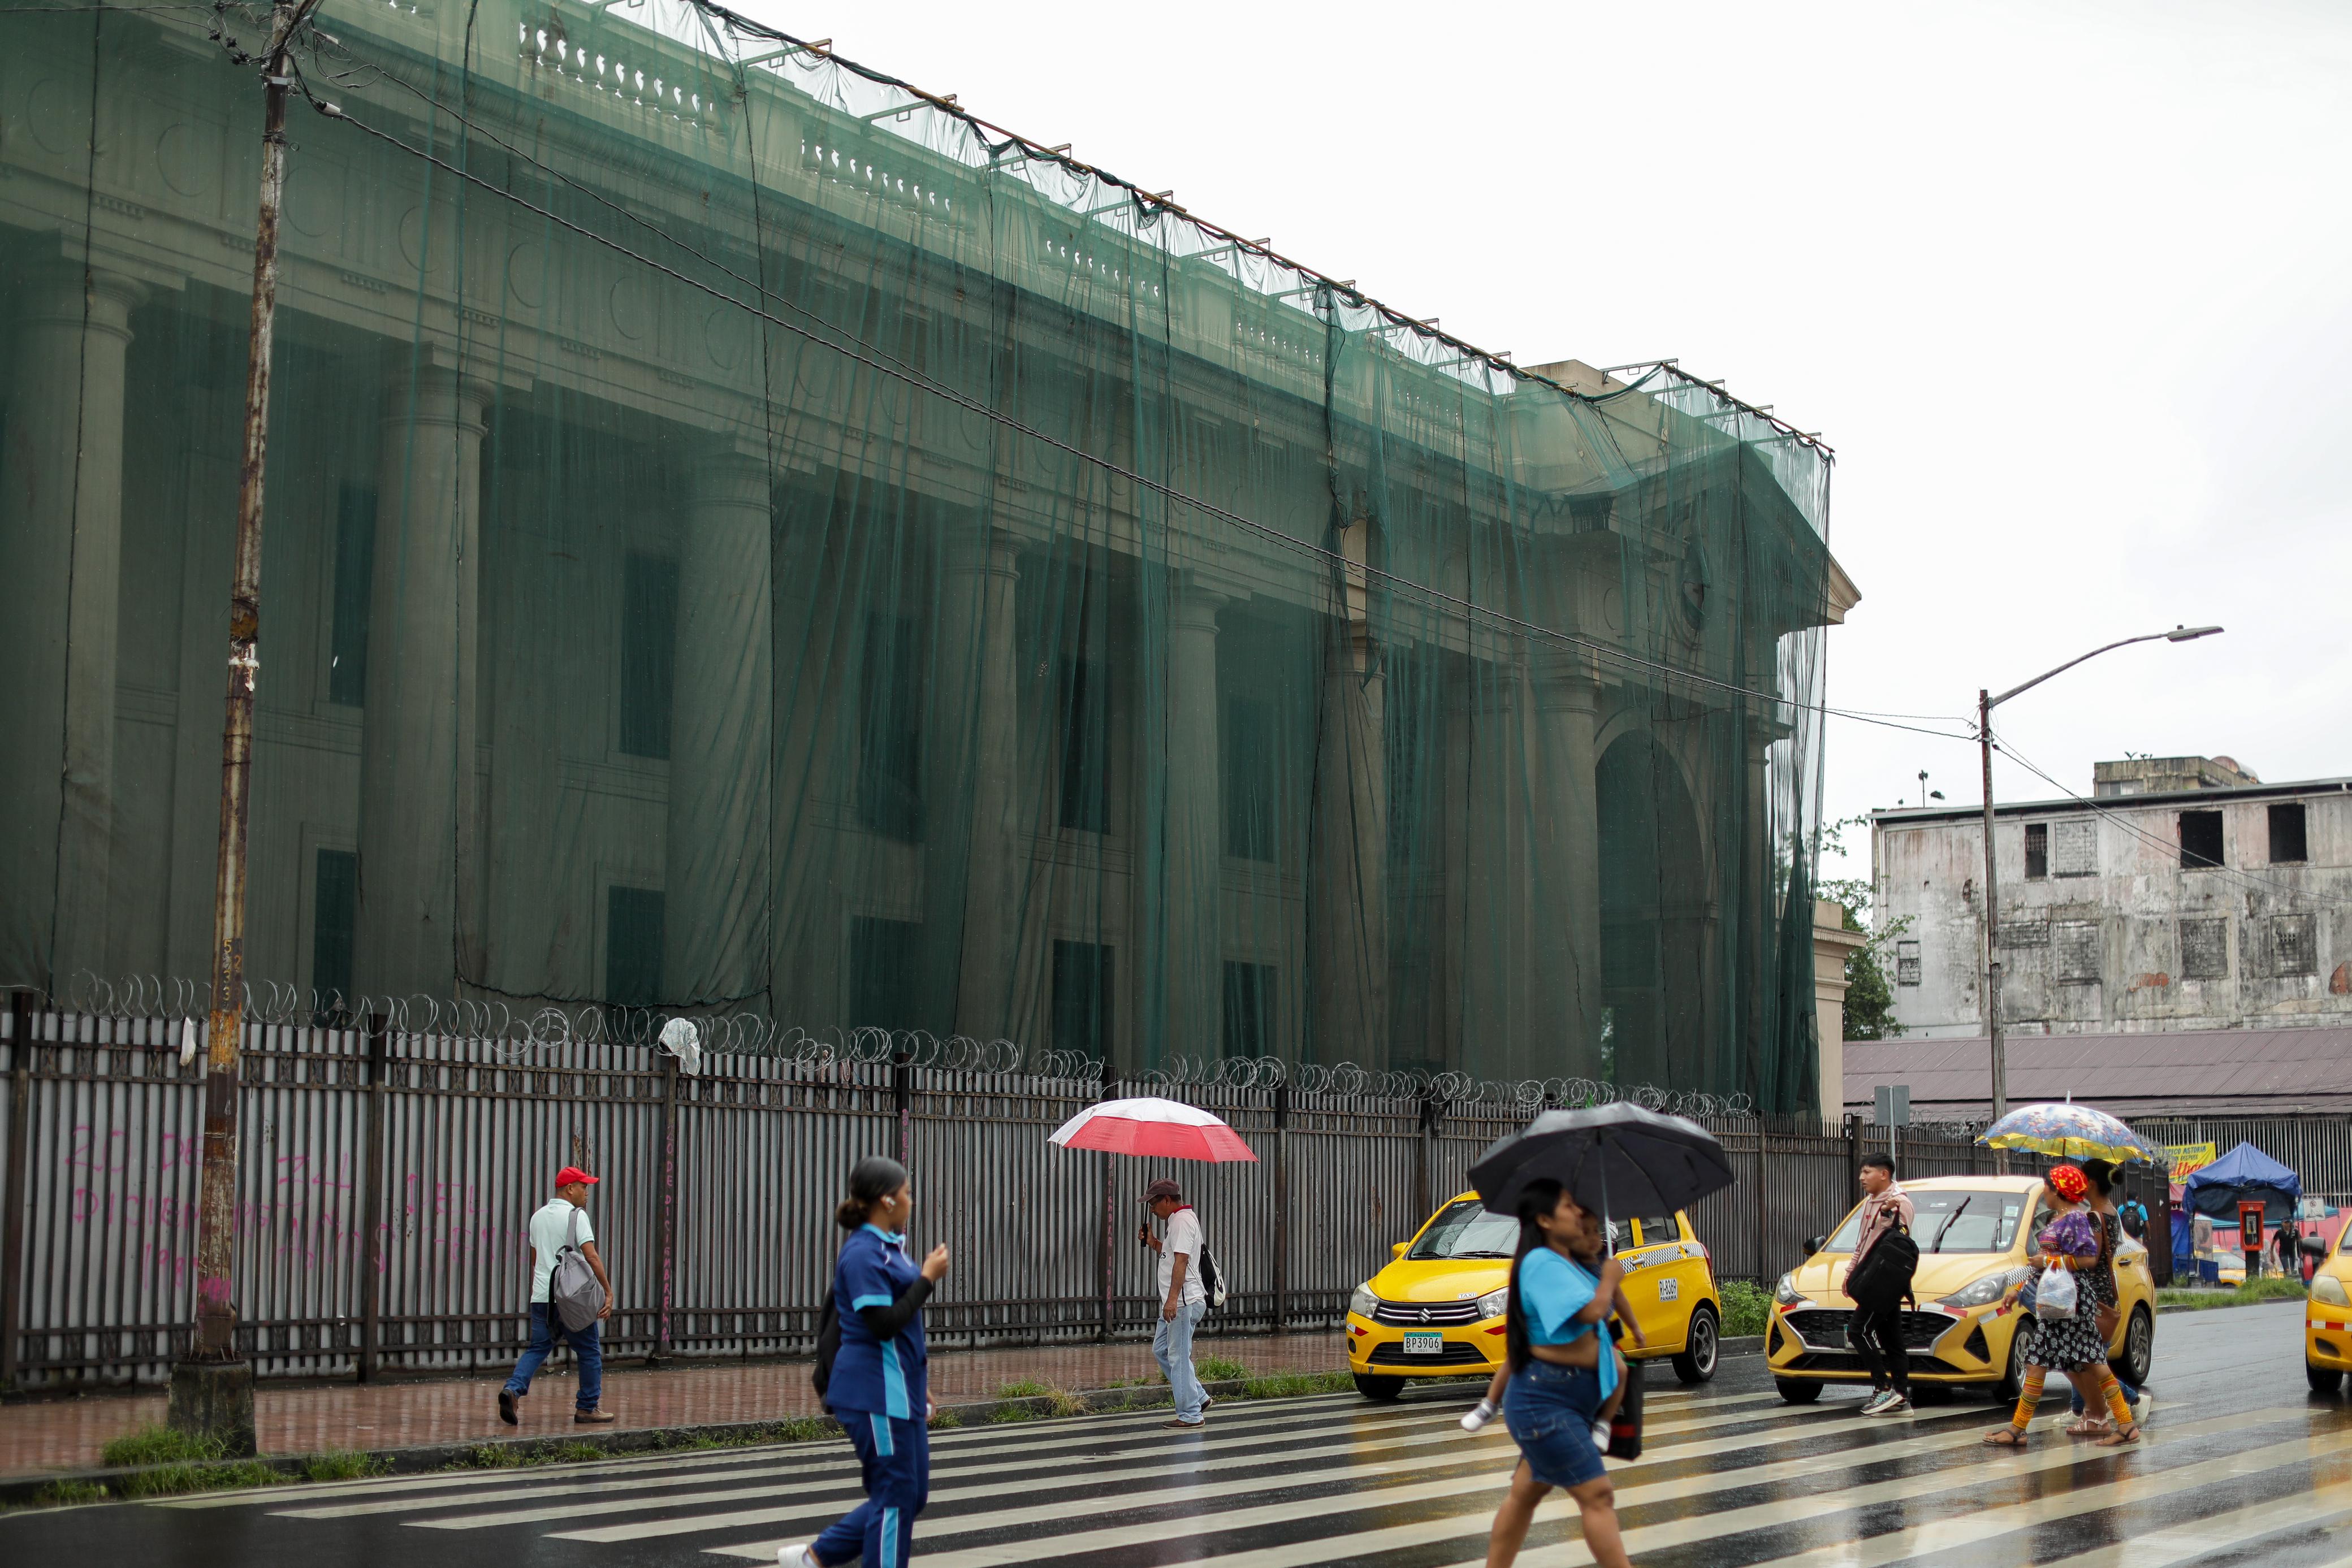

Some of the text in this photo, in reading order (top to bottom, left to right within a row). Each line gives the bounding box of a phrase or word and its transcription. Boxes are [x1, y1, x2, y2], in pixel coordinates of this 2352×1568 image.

[65, 1125, 204, 1172] 20 DE
[667, 1125, 675, 1154] 20
[2184, 1145, 2207, 1154] ASTORIA
[666, 1161, 673, 1186] DE
[407, 1172, 488, 1214] DEL
[144, 1243, 198, 1290] 198
[1659, 1279, 1676, 1296] RI-8369
[1406, 1337, 1439, 1348] BP3906
